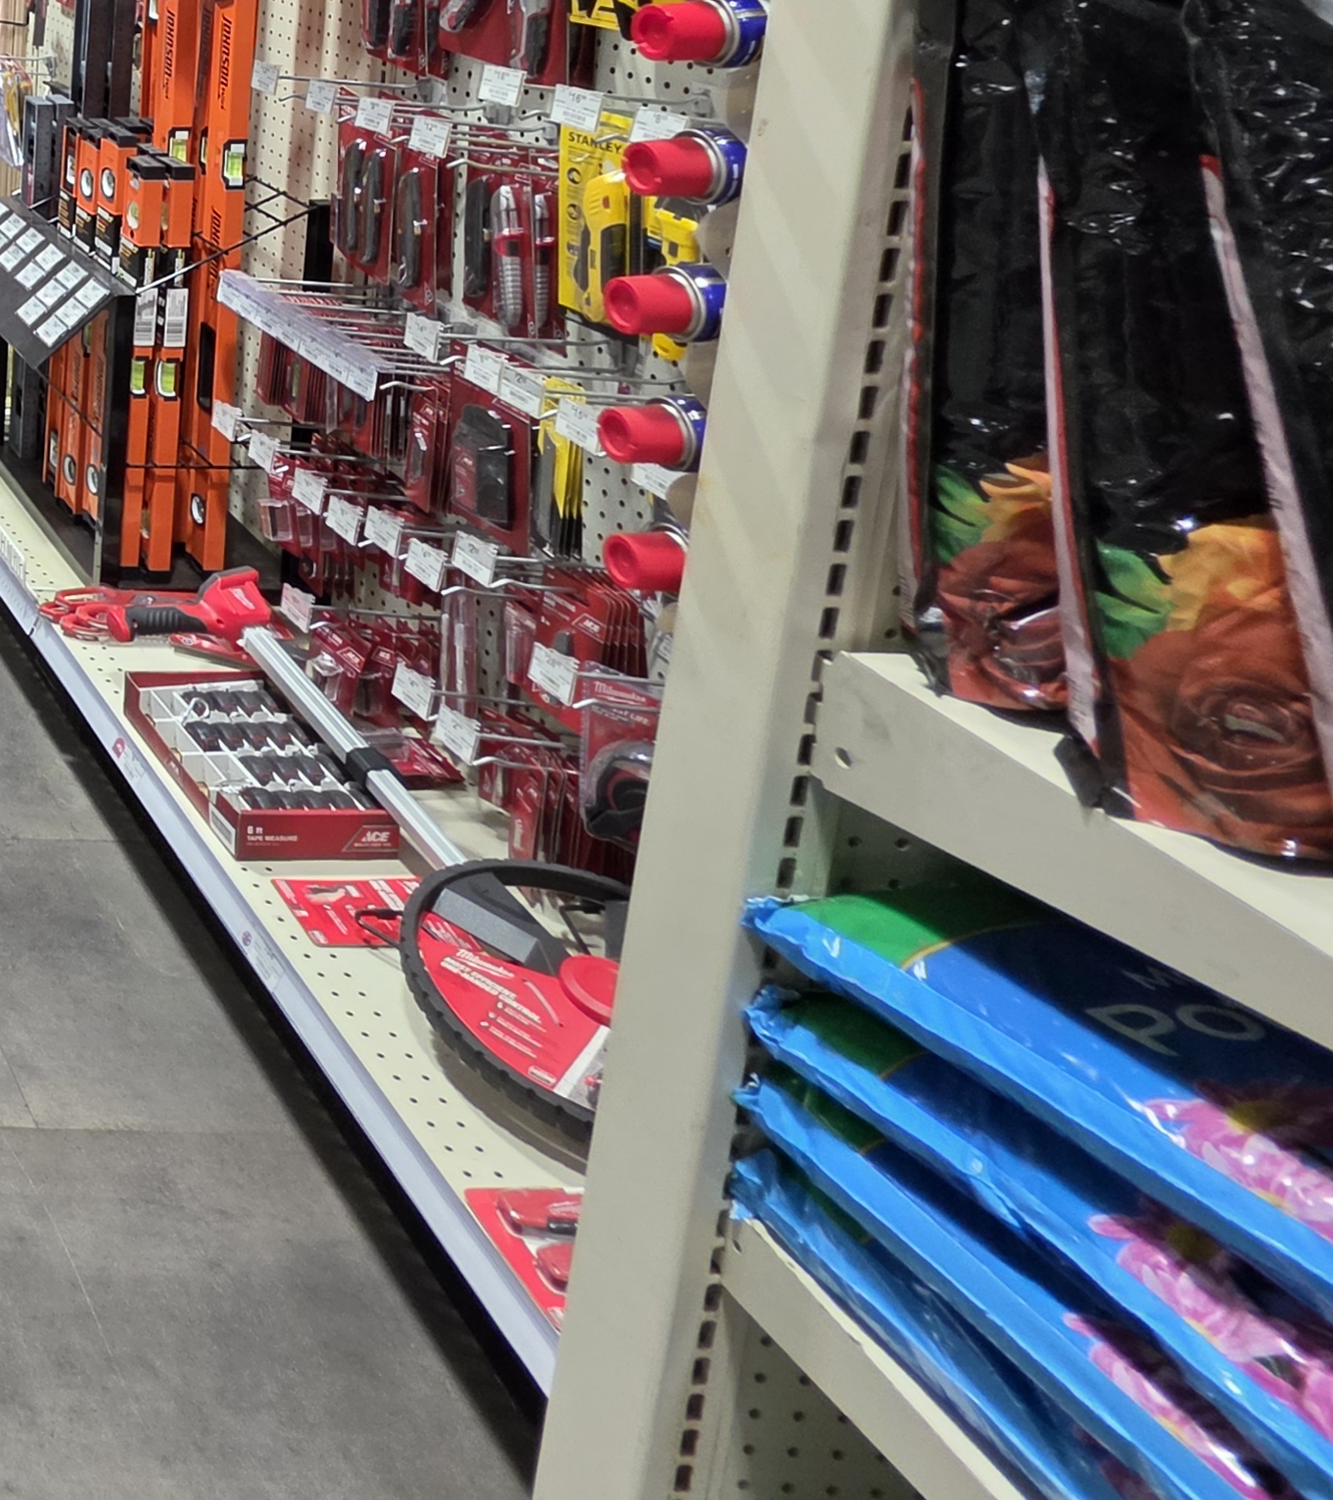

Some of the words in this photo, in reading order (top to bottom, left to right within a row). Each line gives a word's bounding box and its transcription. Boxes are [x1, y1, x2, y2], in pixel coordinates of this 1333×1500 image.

[164, 7, 175, 78] JOHNSON
[220, 13, 232, 88] JOHNSON
[361, 831, 390, 842] ACE
